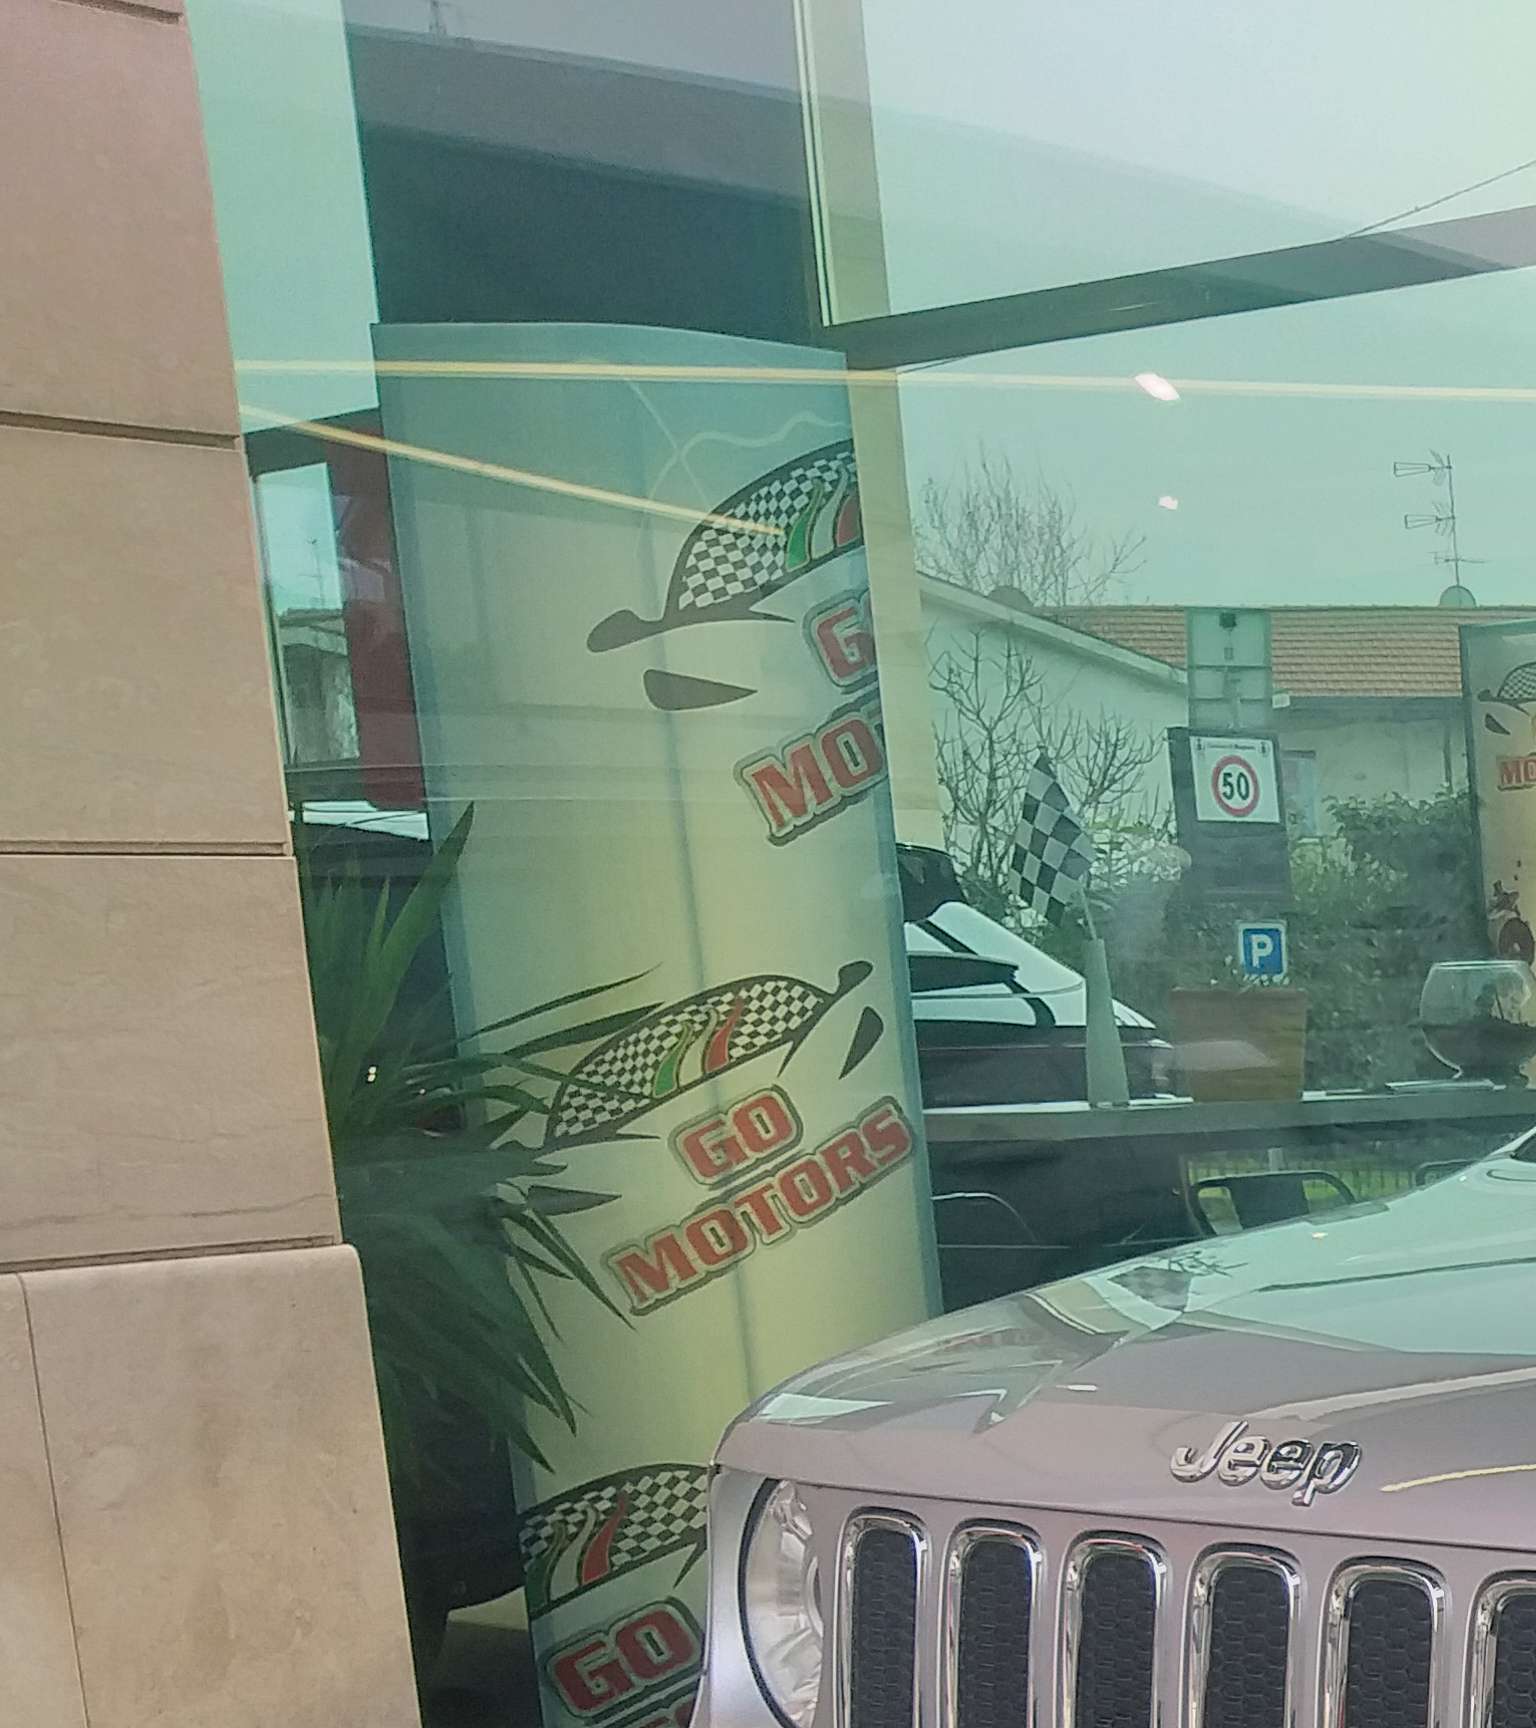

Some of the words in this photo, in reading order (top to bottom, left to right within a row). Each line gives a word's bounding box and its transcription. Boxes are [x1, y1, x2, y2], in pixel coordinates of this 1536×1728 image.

[812, 600, 877, 683] G
[1221, 771, 1251, 801] 50
[1250, 933, 1274, 969] P
[674, 1086, 801, 1182] GO
[609, 1099, 917, 1310] MOTORS
[1168, 1420, 1364, 1508] Jeep
[549, 1604, 704, 1716] GO
